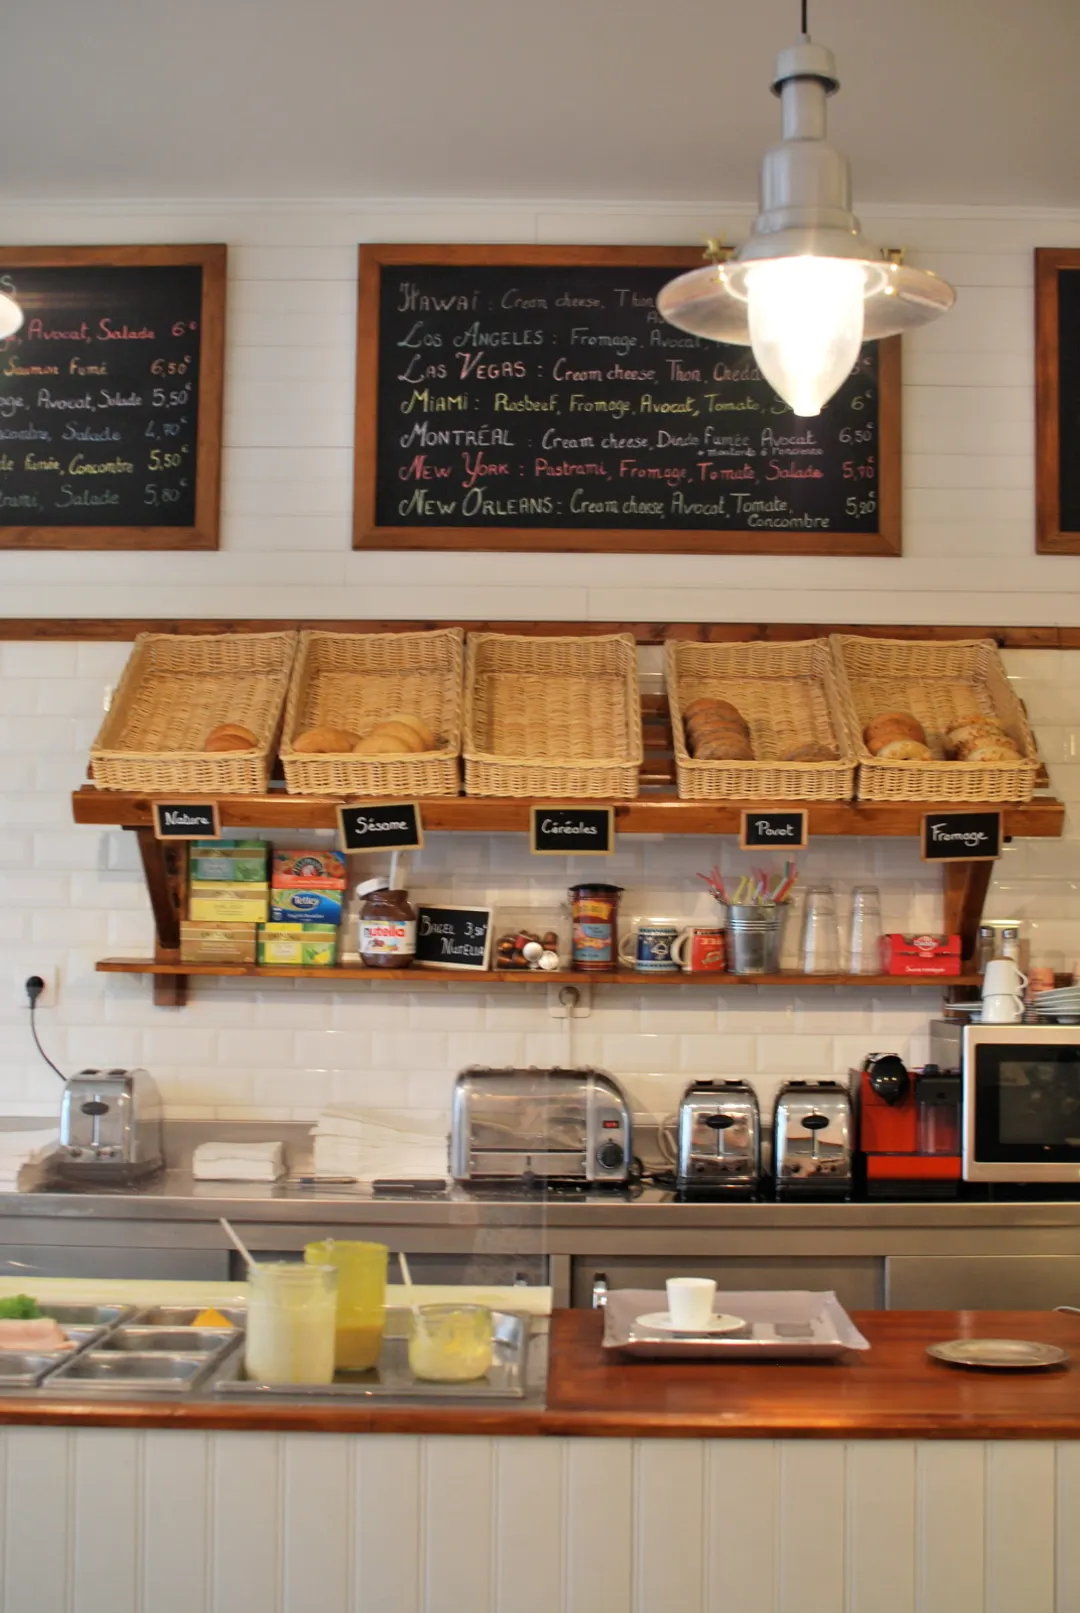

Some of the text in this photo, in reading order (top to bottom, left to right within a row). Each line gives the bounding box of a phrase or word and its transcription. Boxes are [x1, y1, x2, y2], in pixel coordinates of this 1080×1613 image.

[96, 318, 155, 340] Salade
[552, 357, 603, 382] Cream
[541, 428, 595, 450] Cream
[569, 488, 620, 514] Cream
[747, 512, 831, 528] Concombre
[164, 810, 211, 827] Nature
[355, 815, 409, 835] Sésame
[541, 818, 598, 836] Céréales
[930, 822, 989, 847] Fromage
[363, 925, 406, 938] nutella
